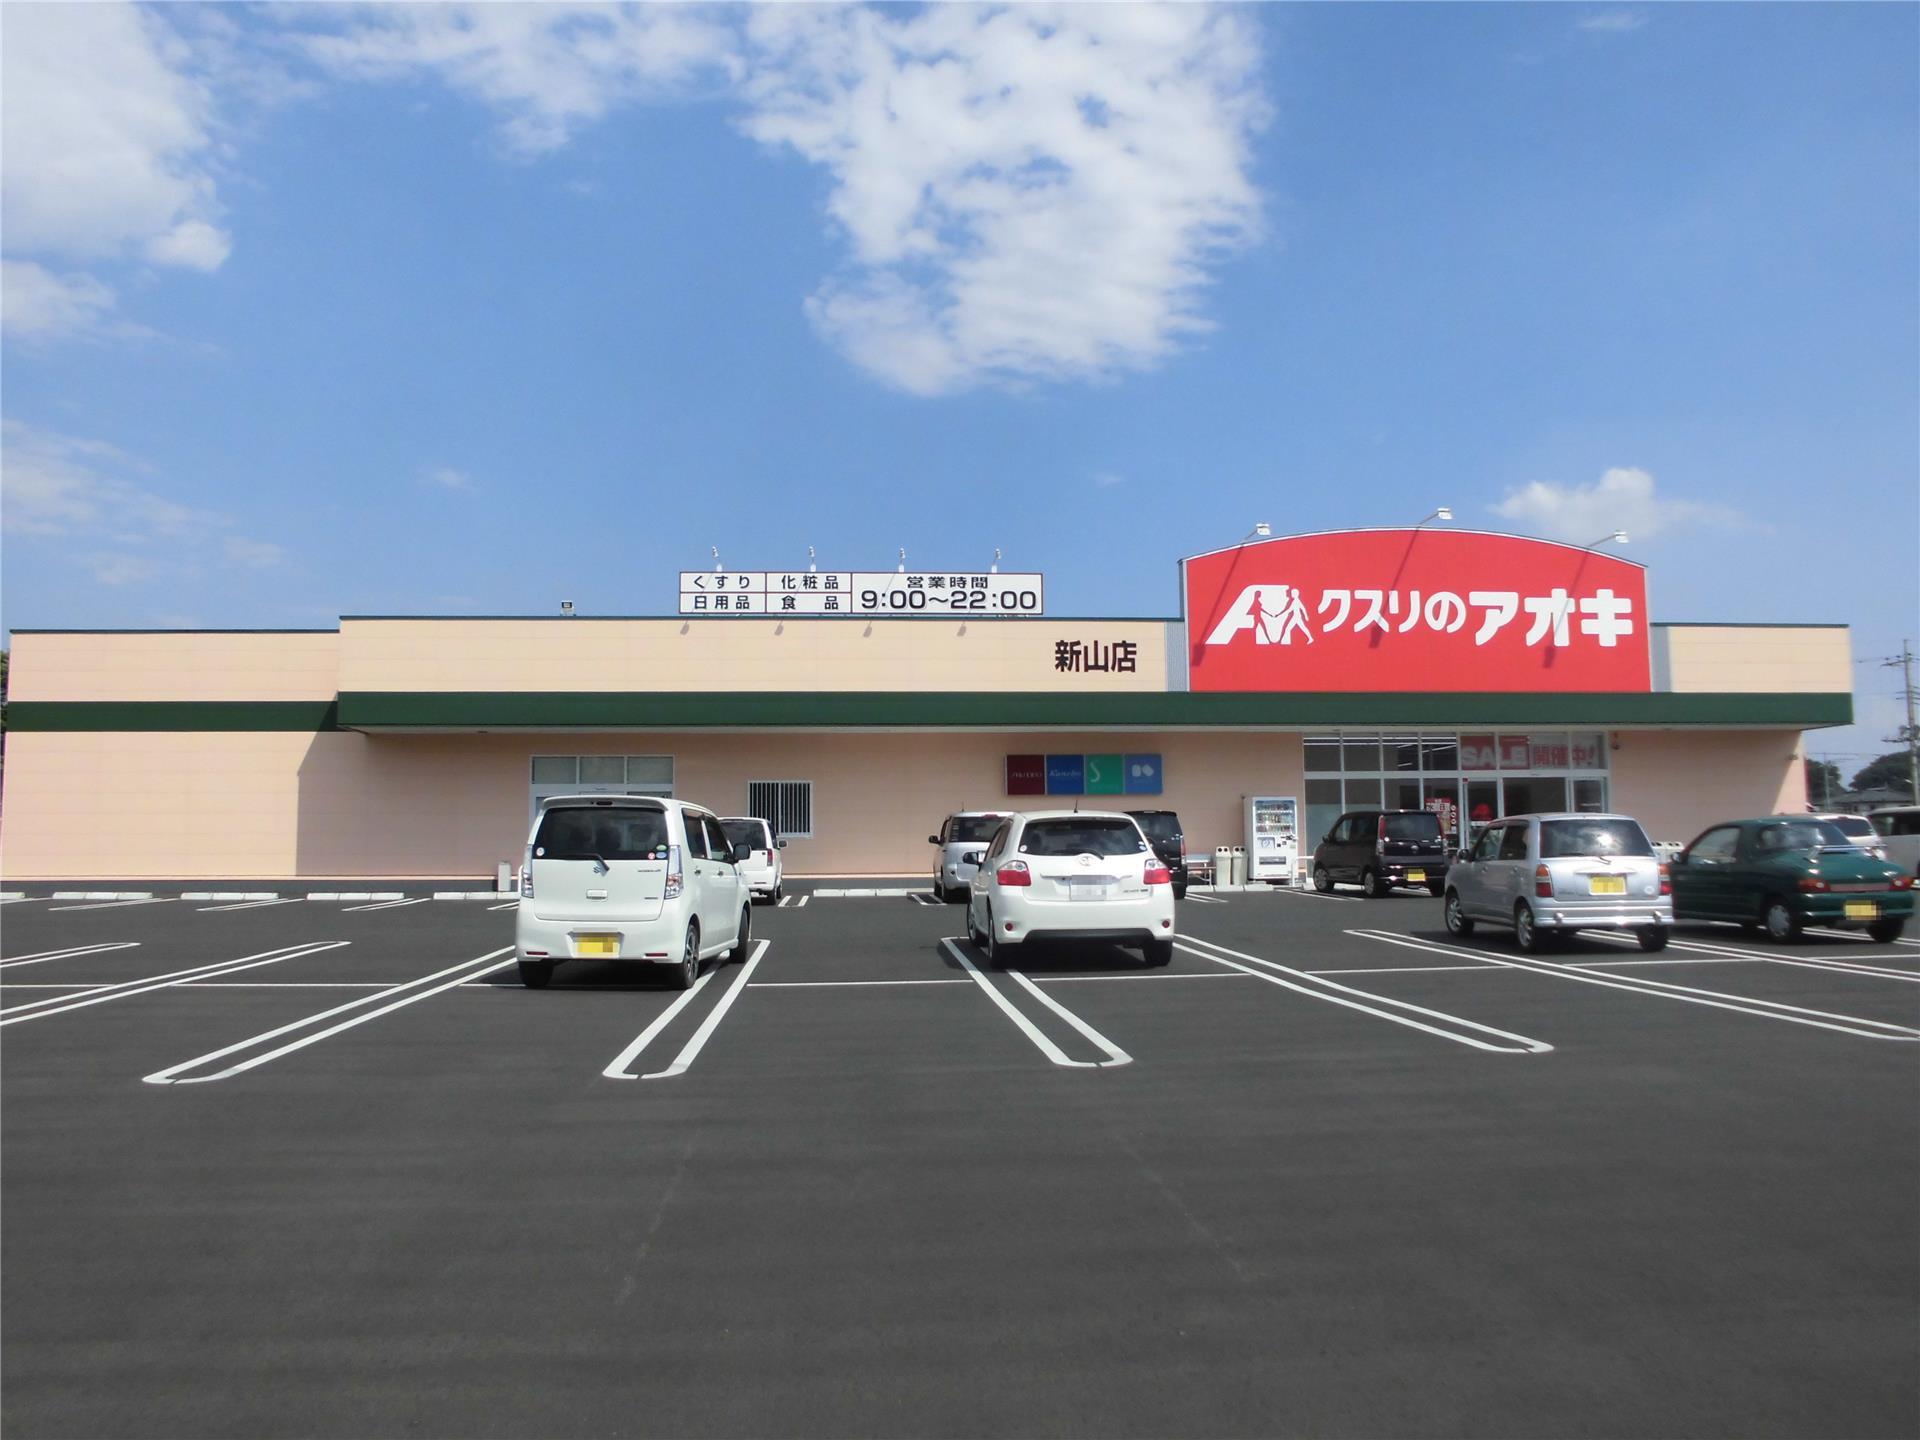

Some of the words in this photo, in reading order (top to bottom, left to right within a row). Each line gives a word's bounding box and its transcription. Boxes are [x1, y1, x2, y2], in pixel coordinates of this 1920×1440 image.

[693, 575, 751, 589] くすり
[781, 575, 839, 590] 化粧品
[906, 576, 989, 589] 営業時間
[694, 595, 750, 610] 日用品
[781, 595, 839, 610] 食品
[1317, 588, 1634, 647] クスリのアオキ
[1055, 640, 1137, 672] 新山店
[1461, 745, 1527, 767] SALE
